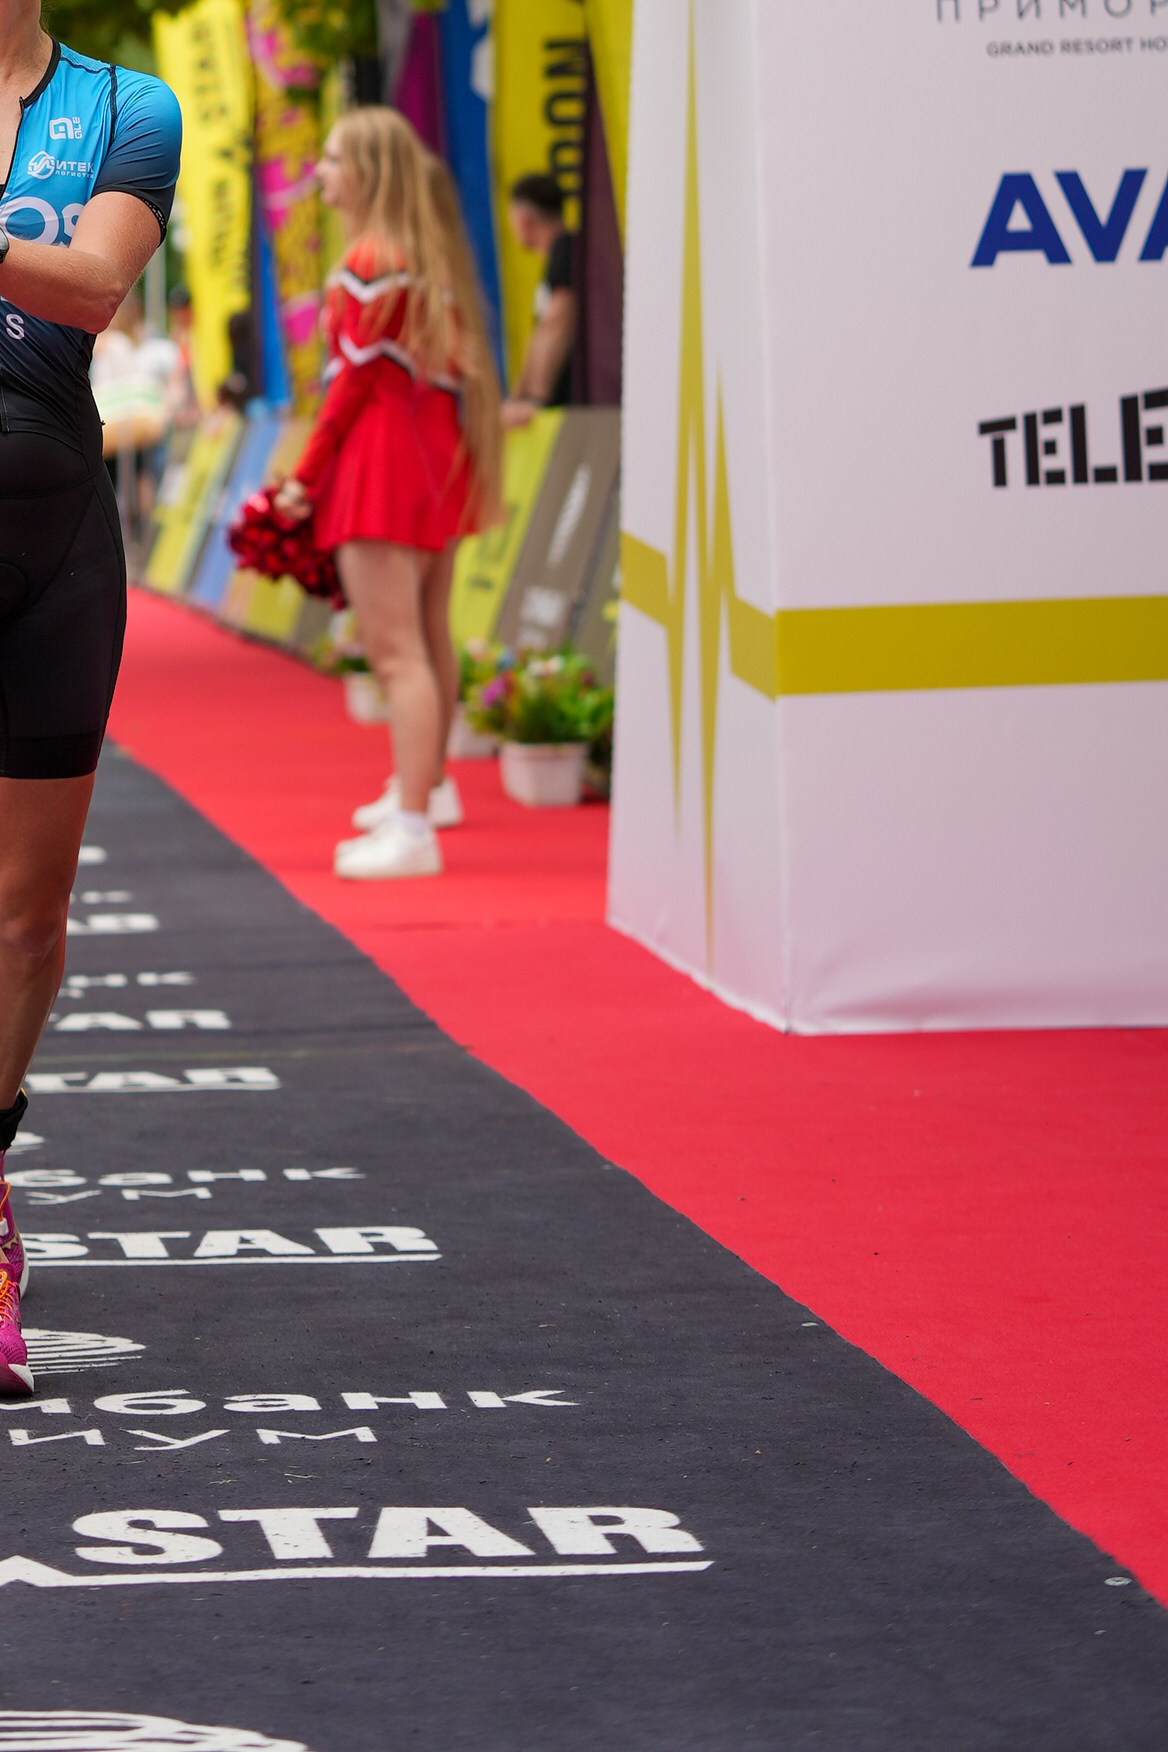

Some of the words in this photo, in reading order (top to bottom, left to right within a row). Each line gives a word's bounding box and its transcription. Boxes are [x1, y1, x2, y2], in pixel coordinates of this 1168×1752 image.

[986, 39, 1055, 58] GRAND
[1059, 36, 1134, 56] RESORT
[71, 1505, 706, 1566] STAR
